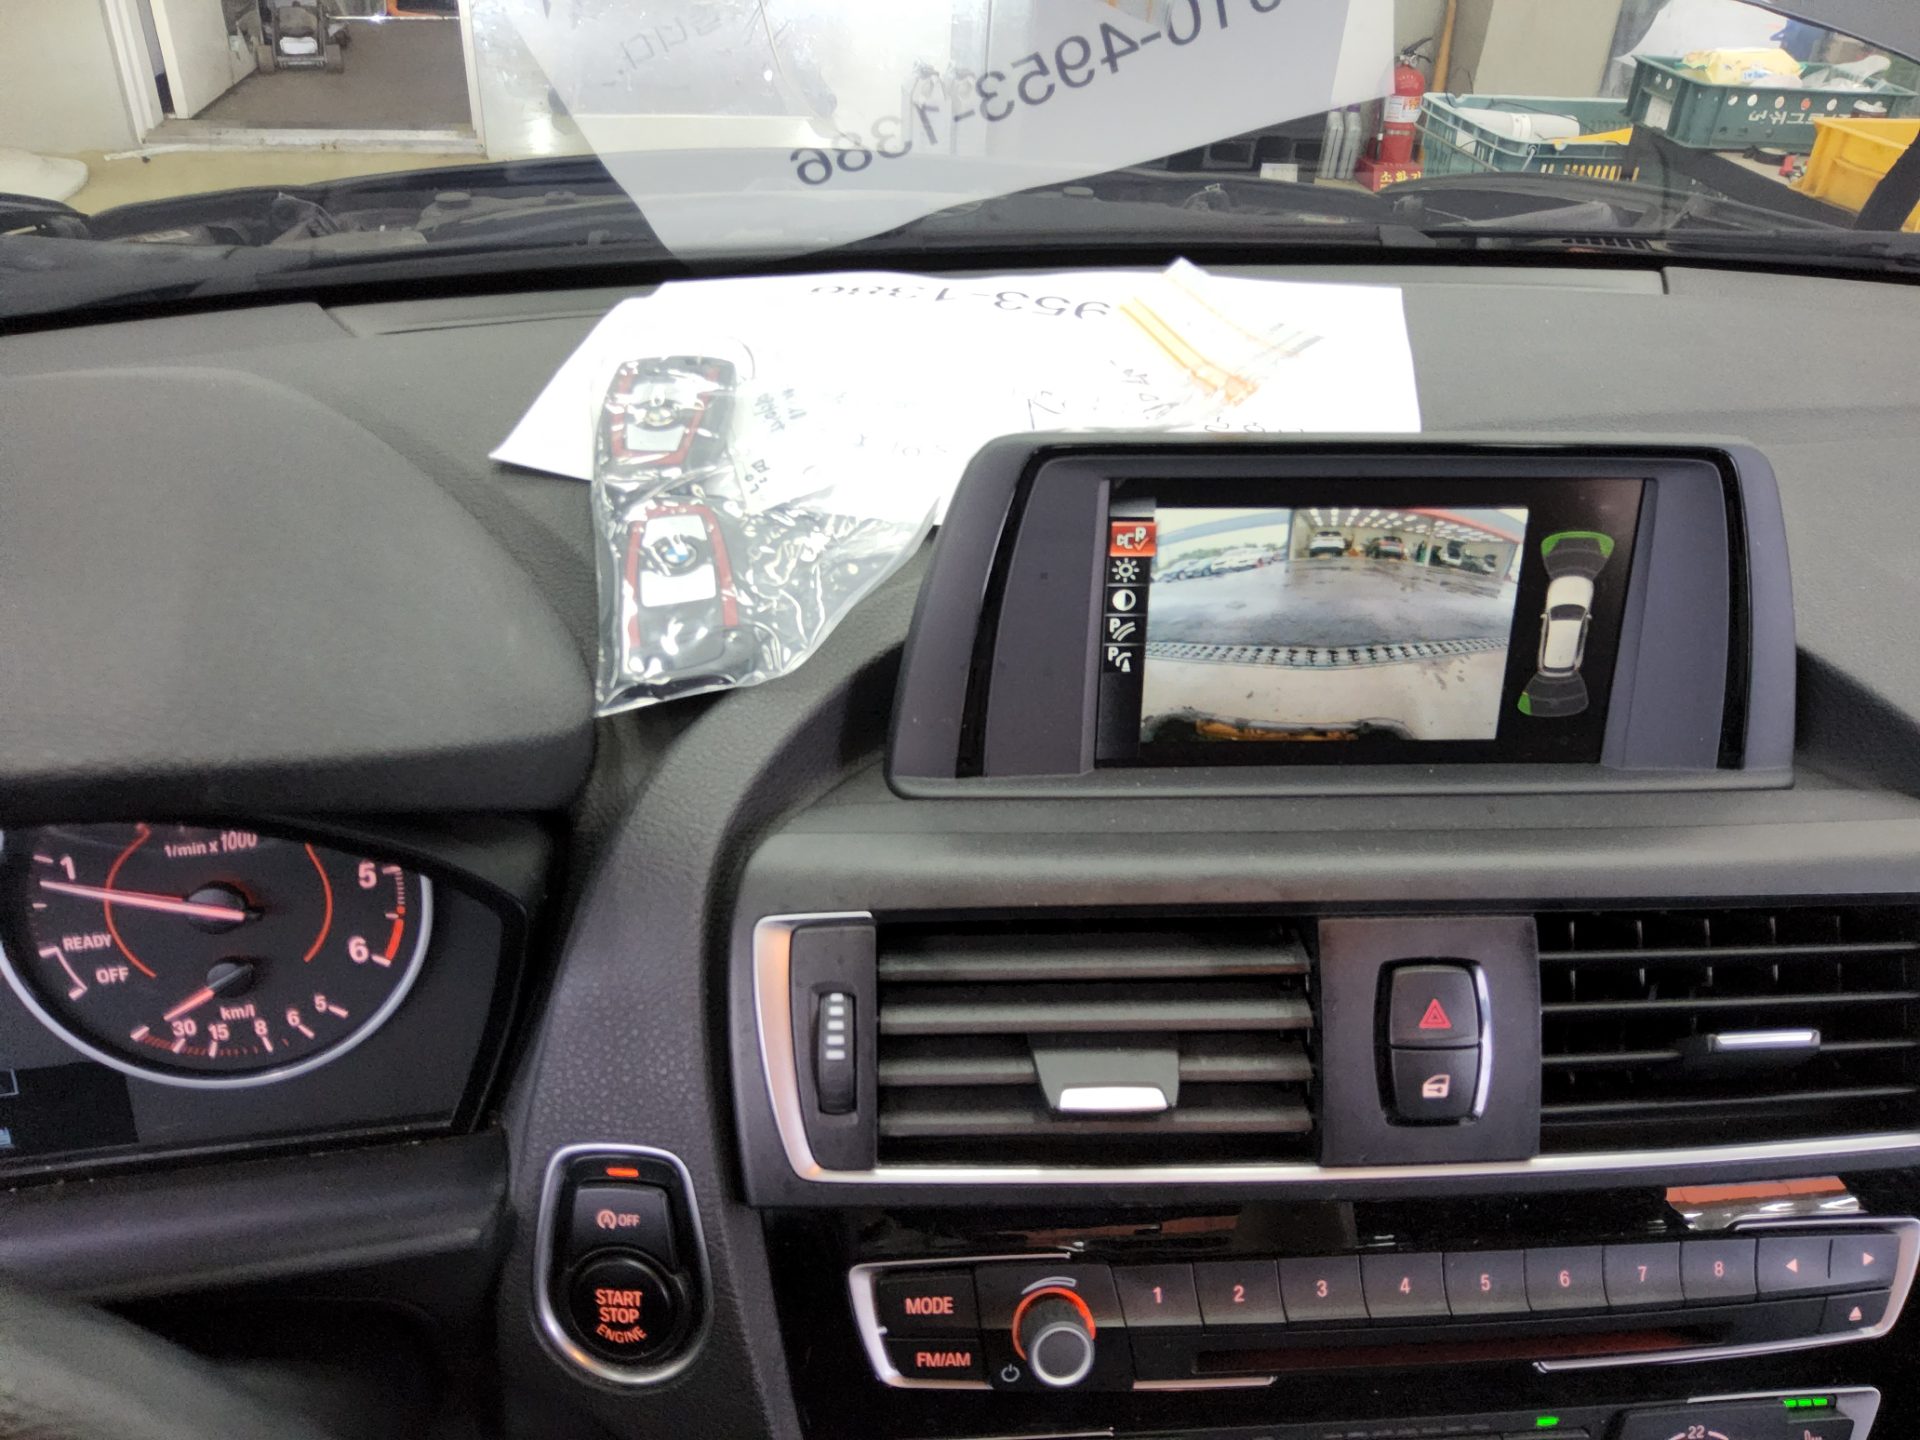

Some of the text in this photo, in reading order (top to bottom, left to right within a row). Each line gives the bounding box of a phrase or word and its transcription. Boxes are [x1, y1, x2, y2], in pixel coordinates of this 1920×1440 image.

[164, 844, 207, 858] 1/min
[220, 831, 258, 851] 1000
[60, 855, 76, 880] 1
[357, 861, 377, 889] 5
[62, 933, 112, 951] READY
[348, 936, 369, 964] 6
[95, 966, 129, 984] OFF
[220, 1003, 256, 1021] km/l
[314, 994, 326, 1013] 5
[172, 1018, 197, 1037] 30
[254, 1018, 268, 1037] 8
[286, 1008, 299, 1028] 6
[208, 1023, 229, 1042] 15
[618, 1213, 640, 1227] OFF
[1558, 1269, 1571, 1288] 6
[1636, 1265, 1648, 1282] 7
[1713, 1260, 1725, 1278] 8
[1316, 1279, 1329, 1298] 3
[1400, 1276, 1412, 1295] 4
[1480, 1273, 1492, 1292] 5
[595, 1288, 643, 1307] START
[1152, 1286, 1163, 1304] 1
[1232, 1284, 1245, 1302] 2
[905, 1296, 954, 1315] MODE
[599, 1307, 640, 1324] STOP
[596, 1323, 647, 1344] ENGINE
[916, 1352, 971, 1368] FM/AM
[1686, 1424, 1706, 1440] 22
